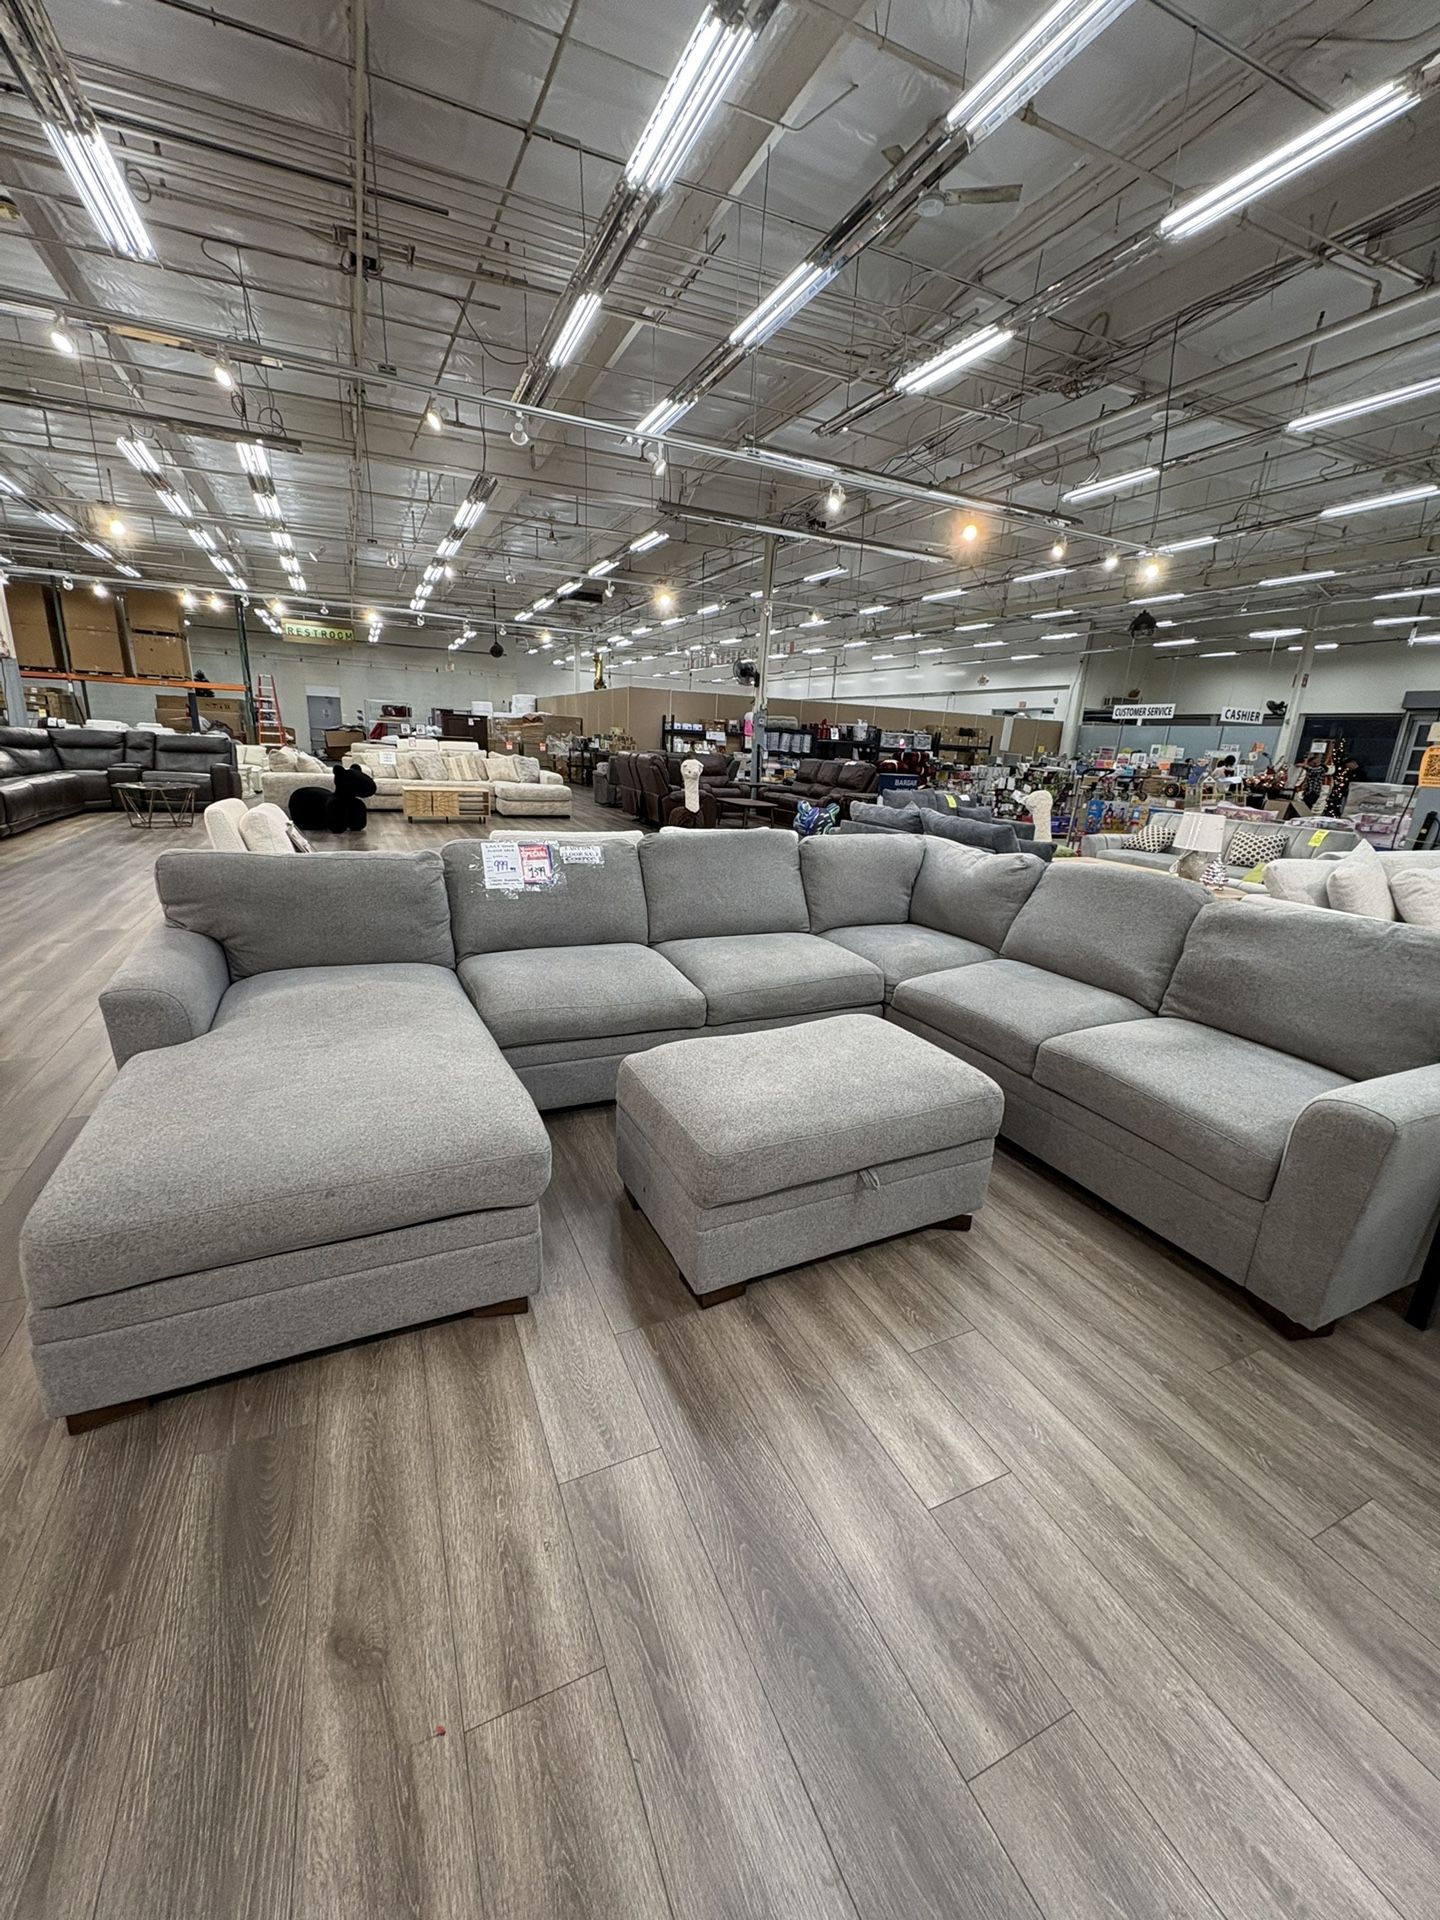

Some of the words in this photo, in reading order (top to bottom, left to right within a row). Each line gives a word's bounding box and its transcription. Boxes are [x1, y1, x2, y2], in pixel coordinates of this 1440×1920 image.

[287, 626, 353, 640] RESTROOM
[1114, 707, 1146, 717] CUSTOMER
[1147, 706, 1173, 716] SERVICE
[1224, 709, 1261, 722] CASHIER
